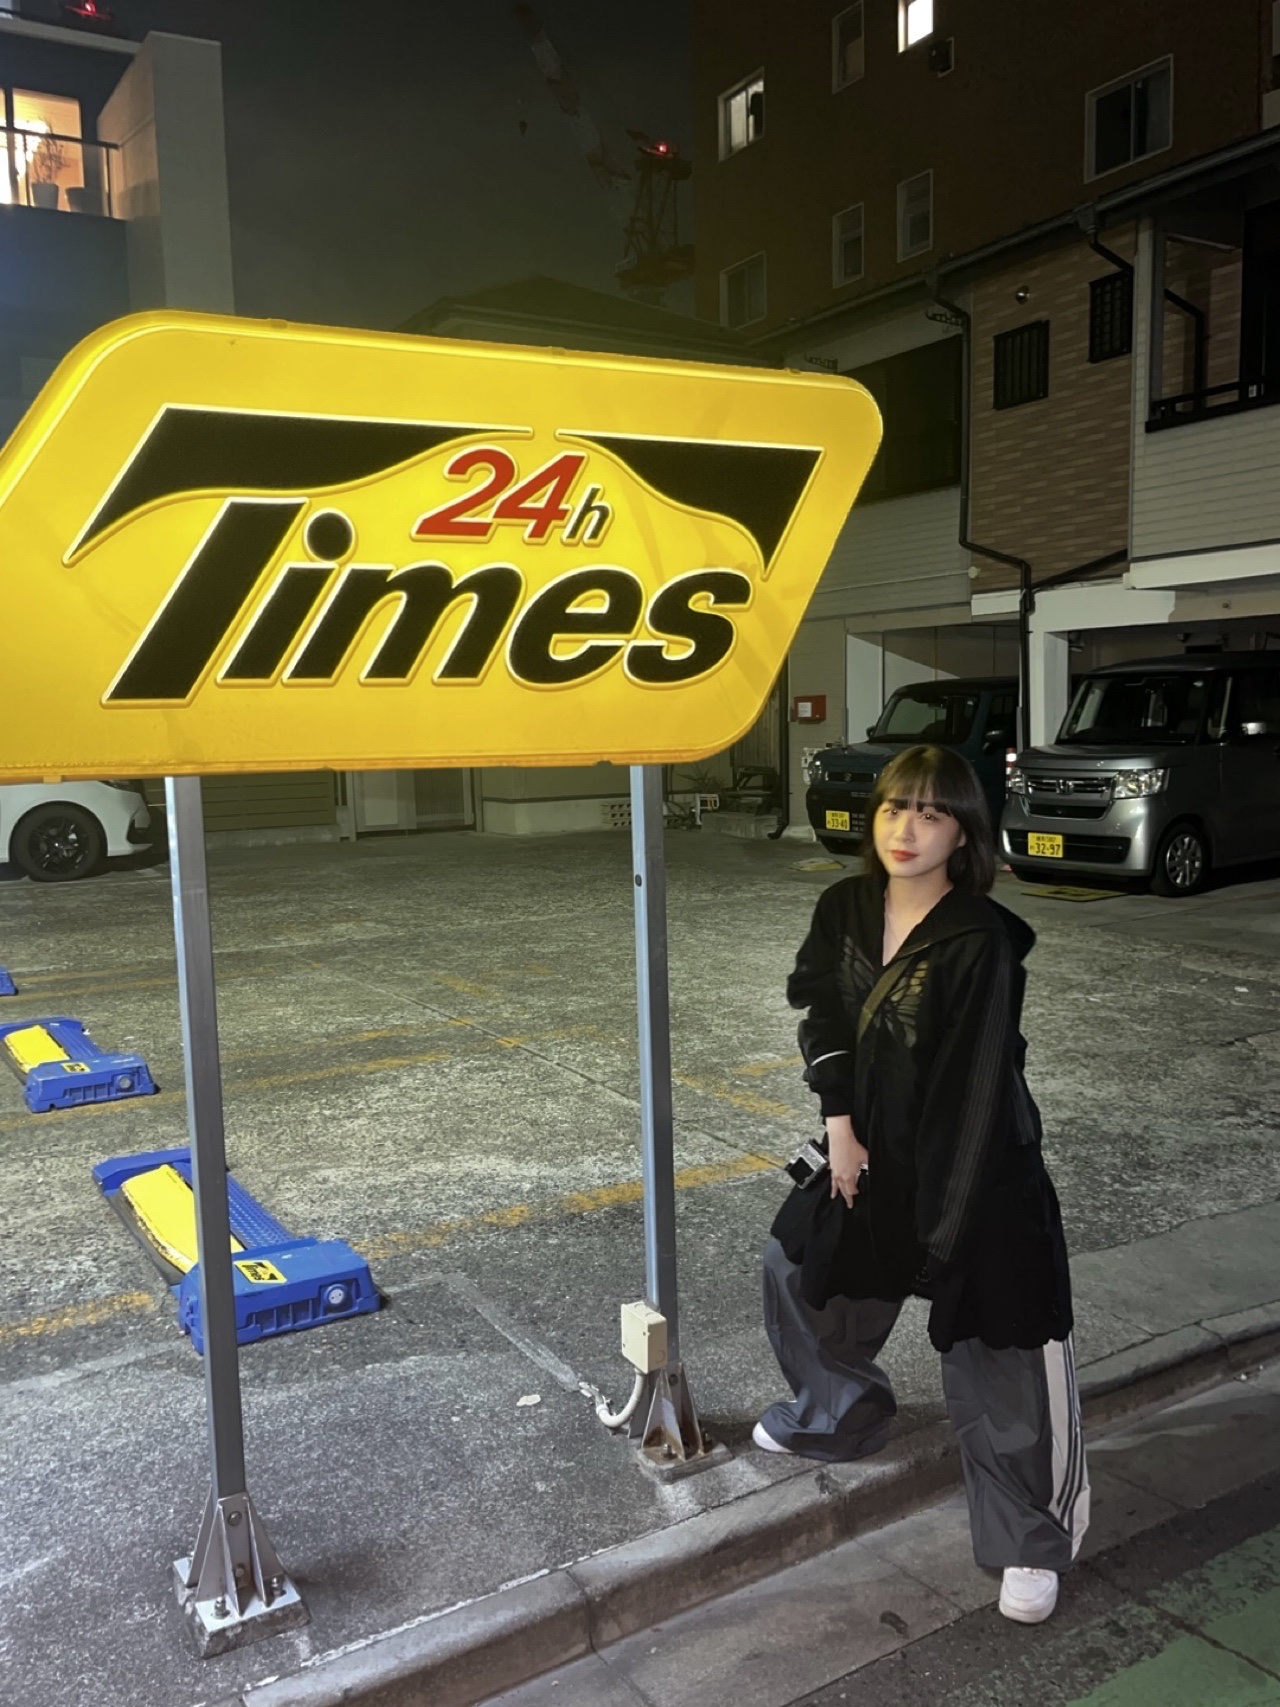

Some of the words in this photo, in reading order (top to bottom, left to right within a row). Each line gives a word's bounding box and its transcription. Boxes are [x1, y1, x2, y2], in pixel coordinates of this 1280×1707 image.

[413, 447, 613, 542] 24h
[102, 497, 753, 705] Times
[1035, 842, 1061, 856] 32-97
